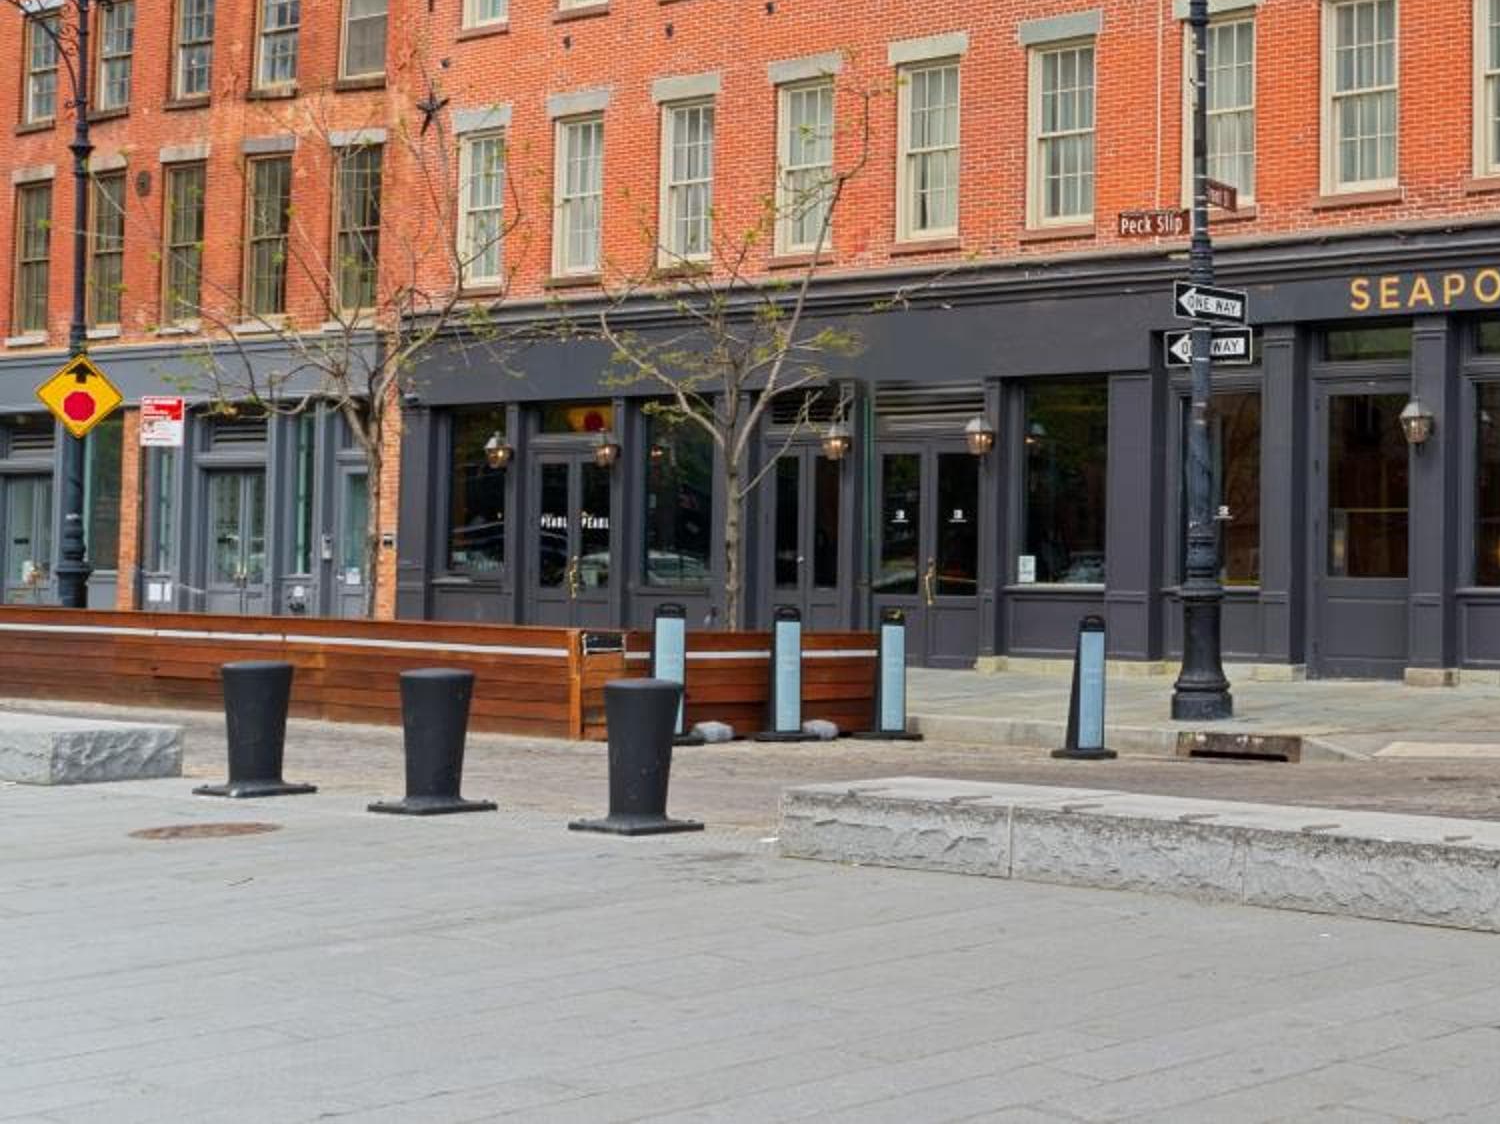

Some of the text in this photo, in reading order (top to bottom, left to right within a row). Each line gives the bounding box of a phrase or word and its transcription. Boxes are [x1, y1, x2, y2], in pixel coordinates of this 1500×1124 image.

[1121, 214, 1183, 235] Peck Slip
[1187, 295, 1237, 314] ONE WAY
[1212, 339, 1239, 354] WAY
